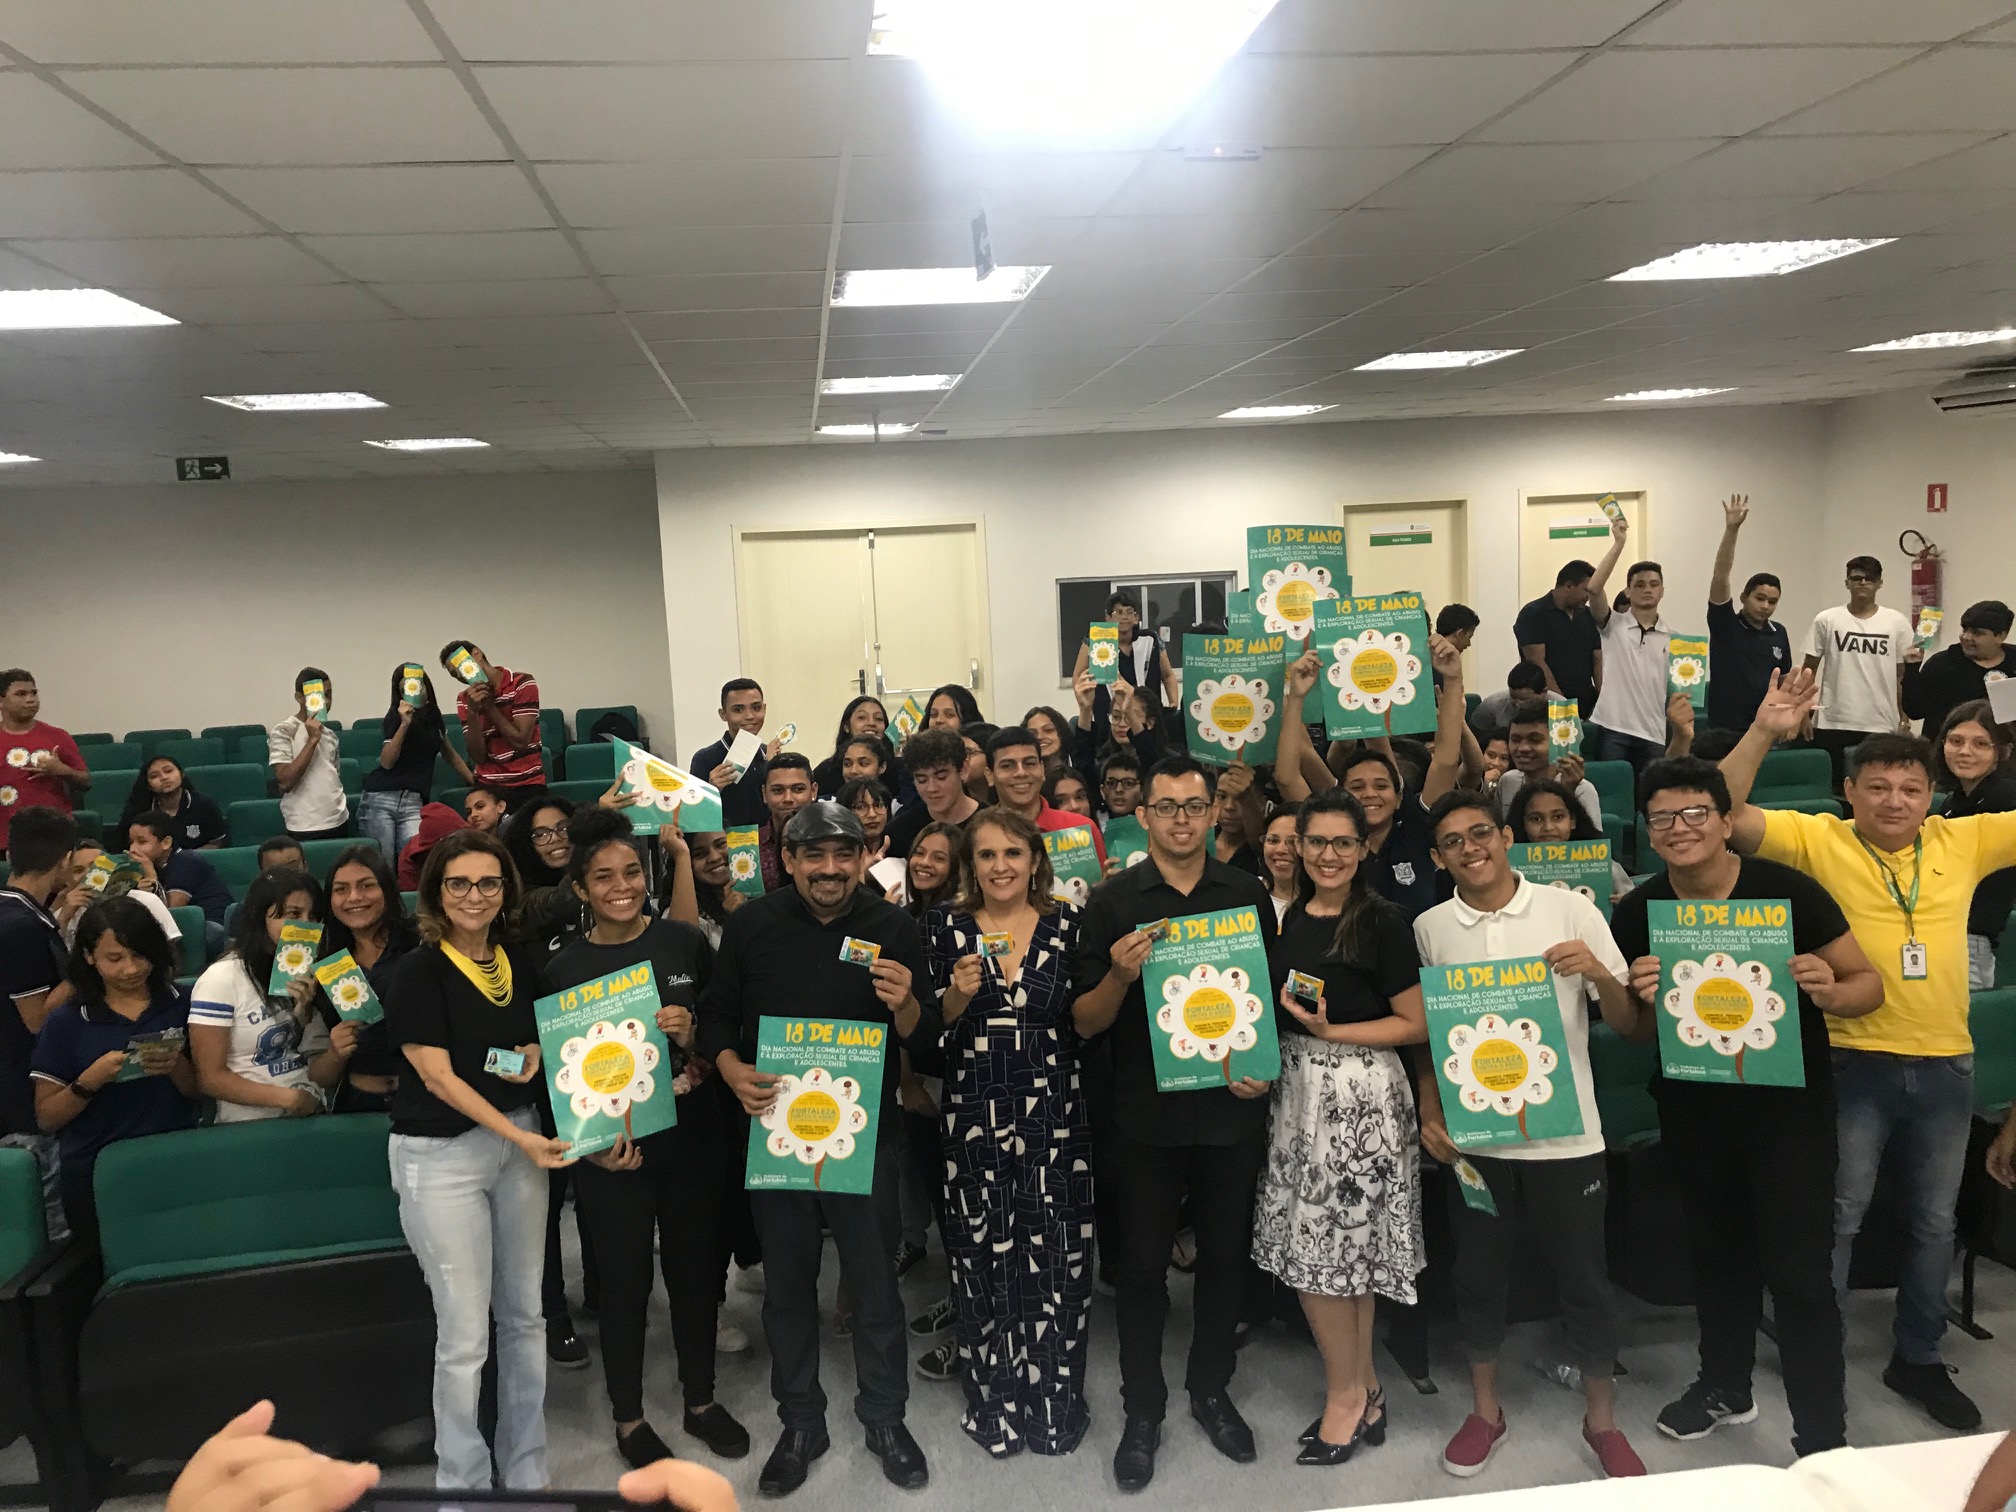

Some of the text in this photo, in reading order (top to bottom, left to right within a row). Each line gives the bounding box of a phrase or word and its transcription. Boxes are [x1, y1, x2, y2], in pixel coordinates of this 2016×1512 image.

[1267, 528, 1342, 544] 18 DE MAIO
[1336, 597, 1419, 614] 18 DE MAIO
[1204, 636, 1284, 655] 18 DE MAIO
[1834, 631, 1889, 655] VANS
[1044, 830, 1090, 853] E MAIO
[1527, 844, 1608, 862] 18 DE MAIO
[1184, 918, 1210, 939] DE
[1214, 912, 1256, 937] MAIO
[1677, 905, 1787, 927] 18 DE MAIO
[1155, 945, 1185, 956] NACIONAL
[1197, 940, 1226, 949] COMBATE
[1239, 934, 1259, 942] ABUSO
[1666, 935, 1712, 943] EXPLORAÇÃO
[1155, 951, 1196, 963] EXPLORAÇÃO
[1198, 948, 1219, 956] SEXUAL
[1230, 942, 1260, 952] CRIANÇAS
[1446, 961, 1546, 990] 18 DE MAIO
[559, 966, 649, 1011] 18 DE MAIO
[1439, 993, 1470, 1002] NACIONAL
[1481, 989, 1513, 997] COMBATE
[552, 1009, 582, 1024] NACIONAL
[592, 996, 621, 1010] COMBATE
[632, 985, 652, 995] ABUSO
[552, 1012, 592, 1029] EXPLORAÇÃO
[593, 1005, 614, 1016] SEXUAL
[625, 992, 654, 1004] CRIANÇAS
[1187, 1003, 1230, 1013] FORTALEZA
[1440, 999, 1481, 1009] EXPLORAÇÃO
[1483, 997, 1506, 1005] SEXUAL
[1518, 991, 1551, 1001] CRIANÇAS
[786, 1023, 882, 1047] 18 DE MAIO
[849, 1055, 880, 1063] CRIANÇAS
[1475, 1055, 1522, 1066] FORTALEZA
